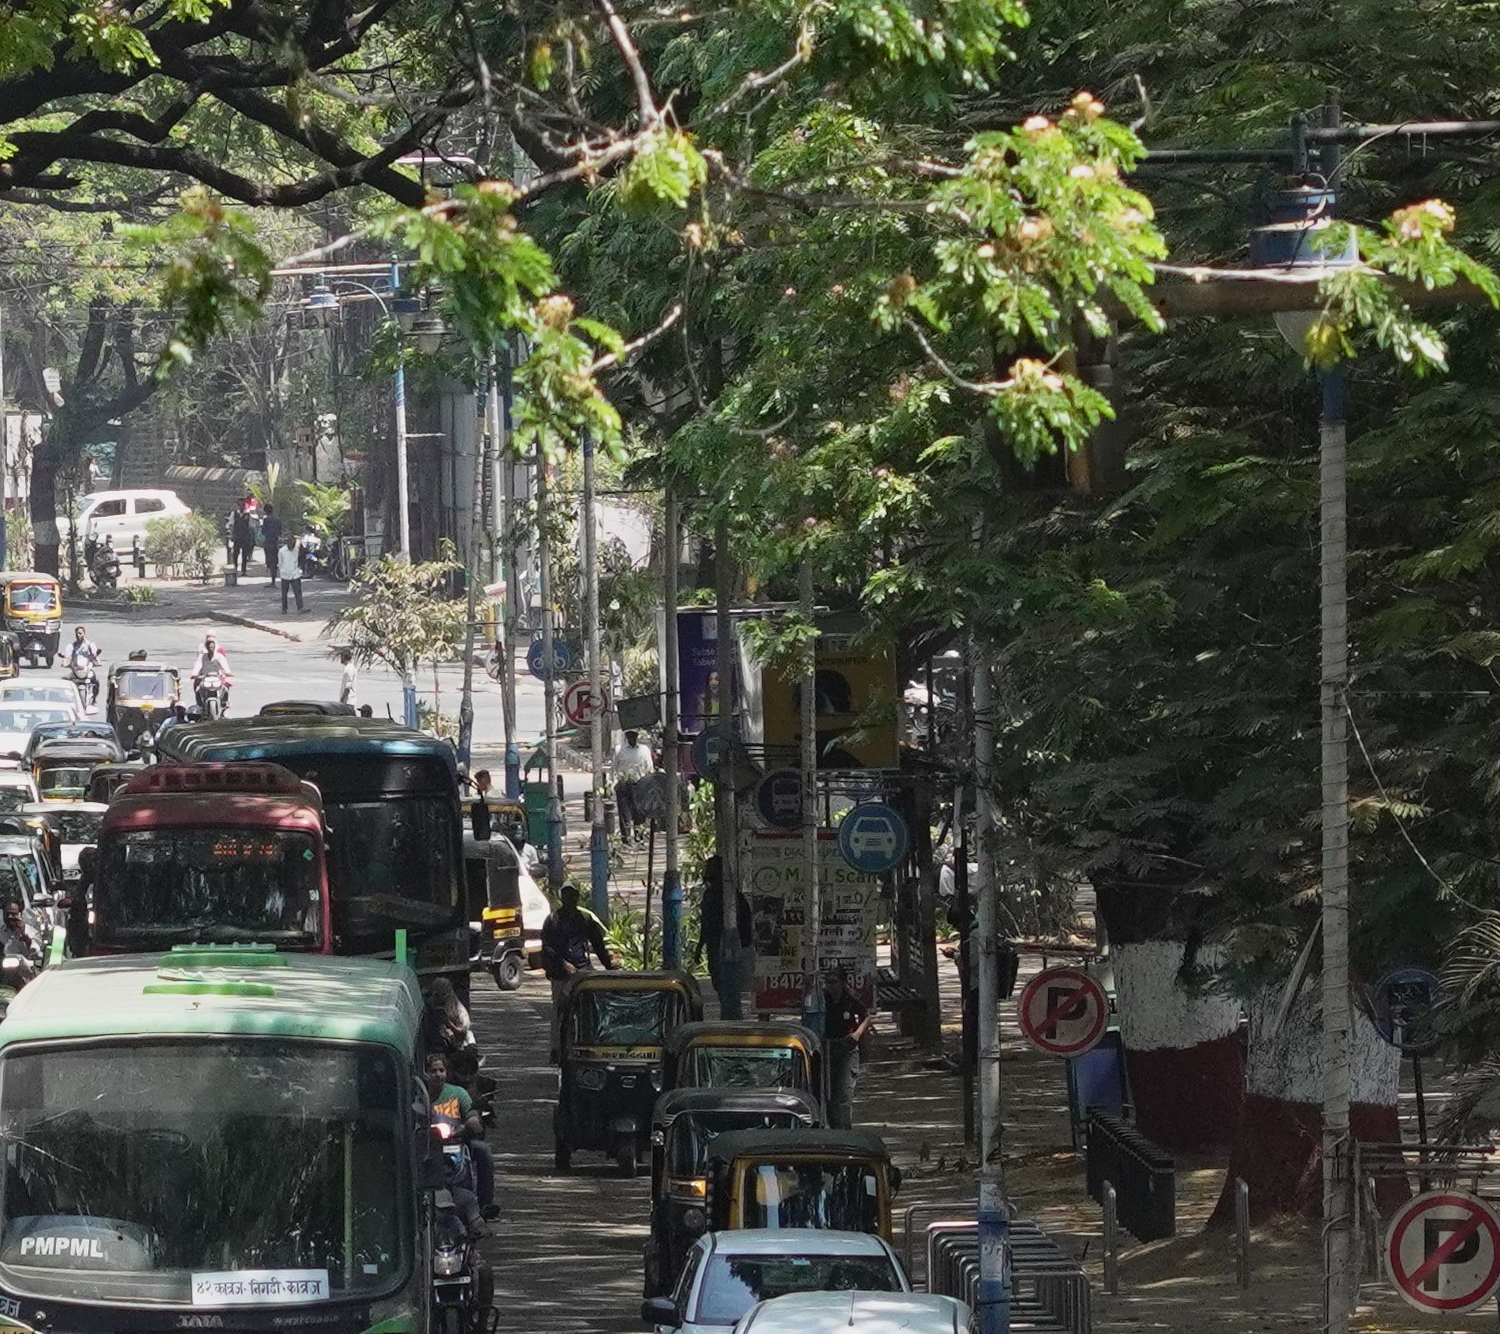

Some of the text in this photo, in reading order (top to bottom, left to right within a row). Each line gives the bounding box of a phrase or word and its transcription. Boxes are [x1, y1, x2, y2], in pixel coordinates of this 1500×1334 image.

[1046, 986, 1088, 1040] P
[20, 1236, 104, 1259] PMPML
[1424, 1218, 1481, 1292] P
